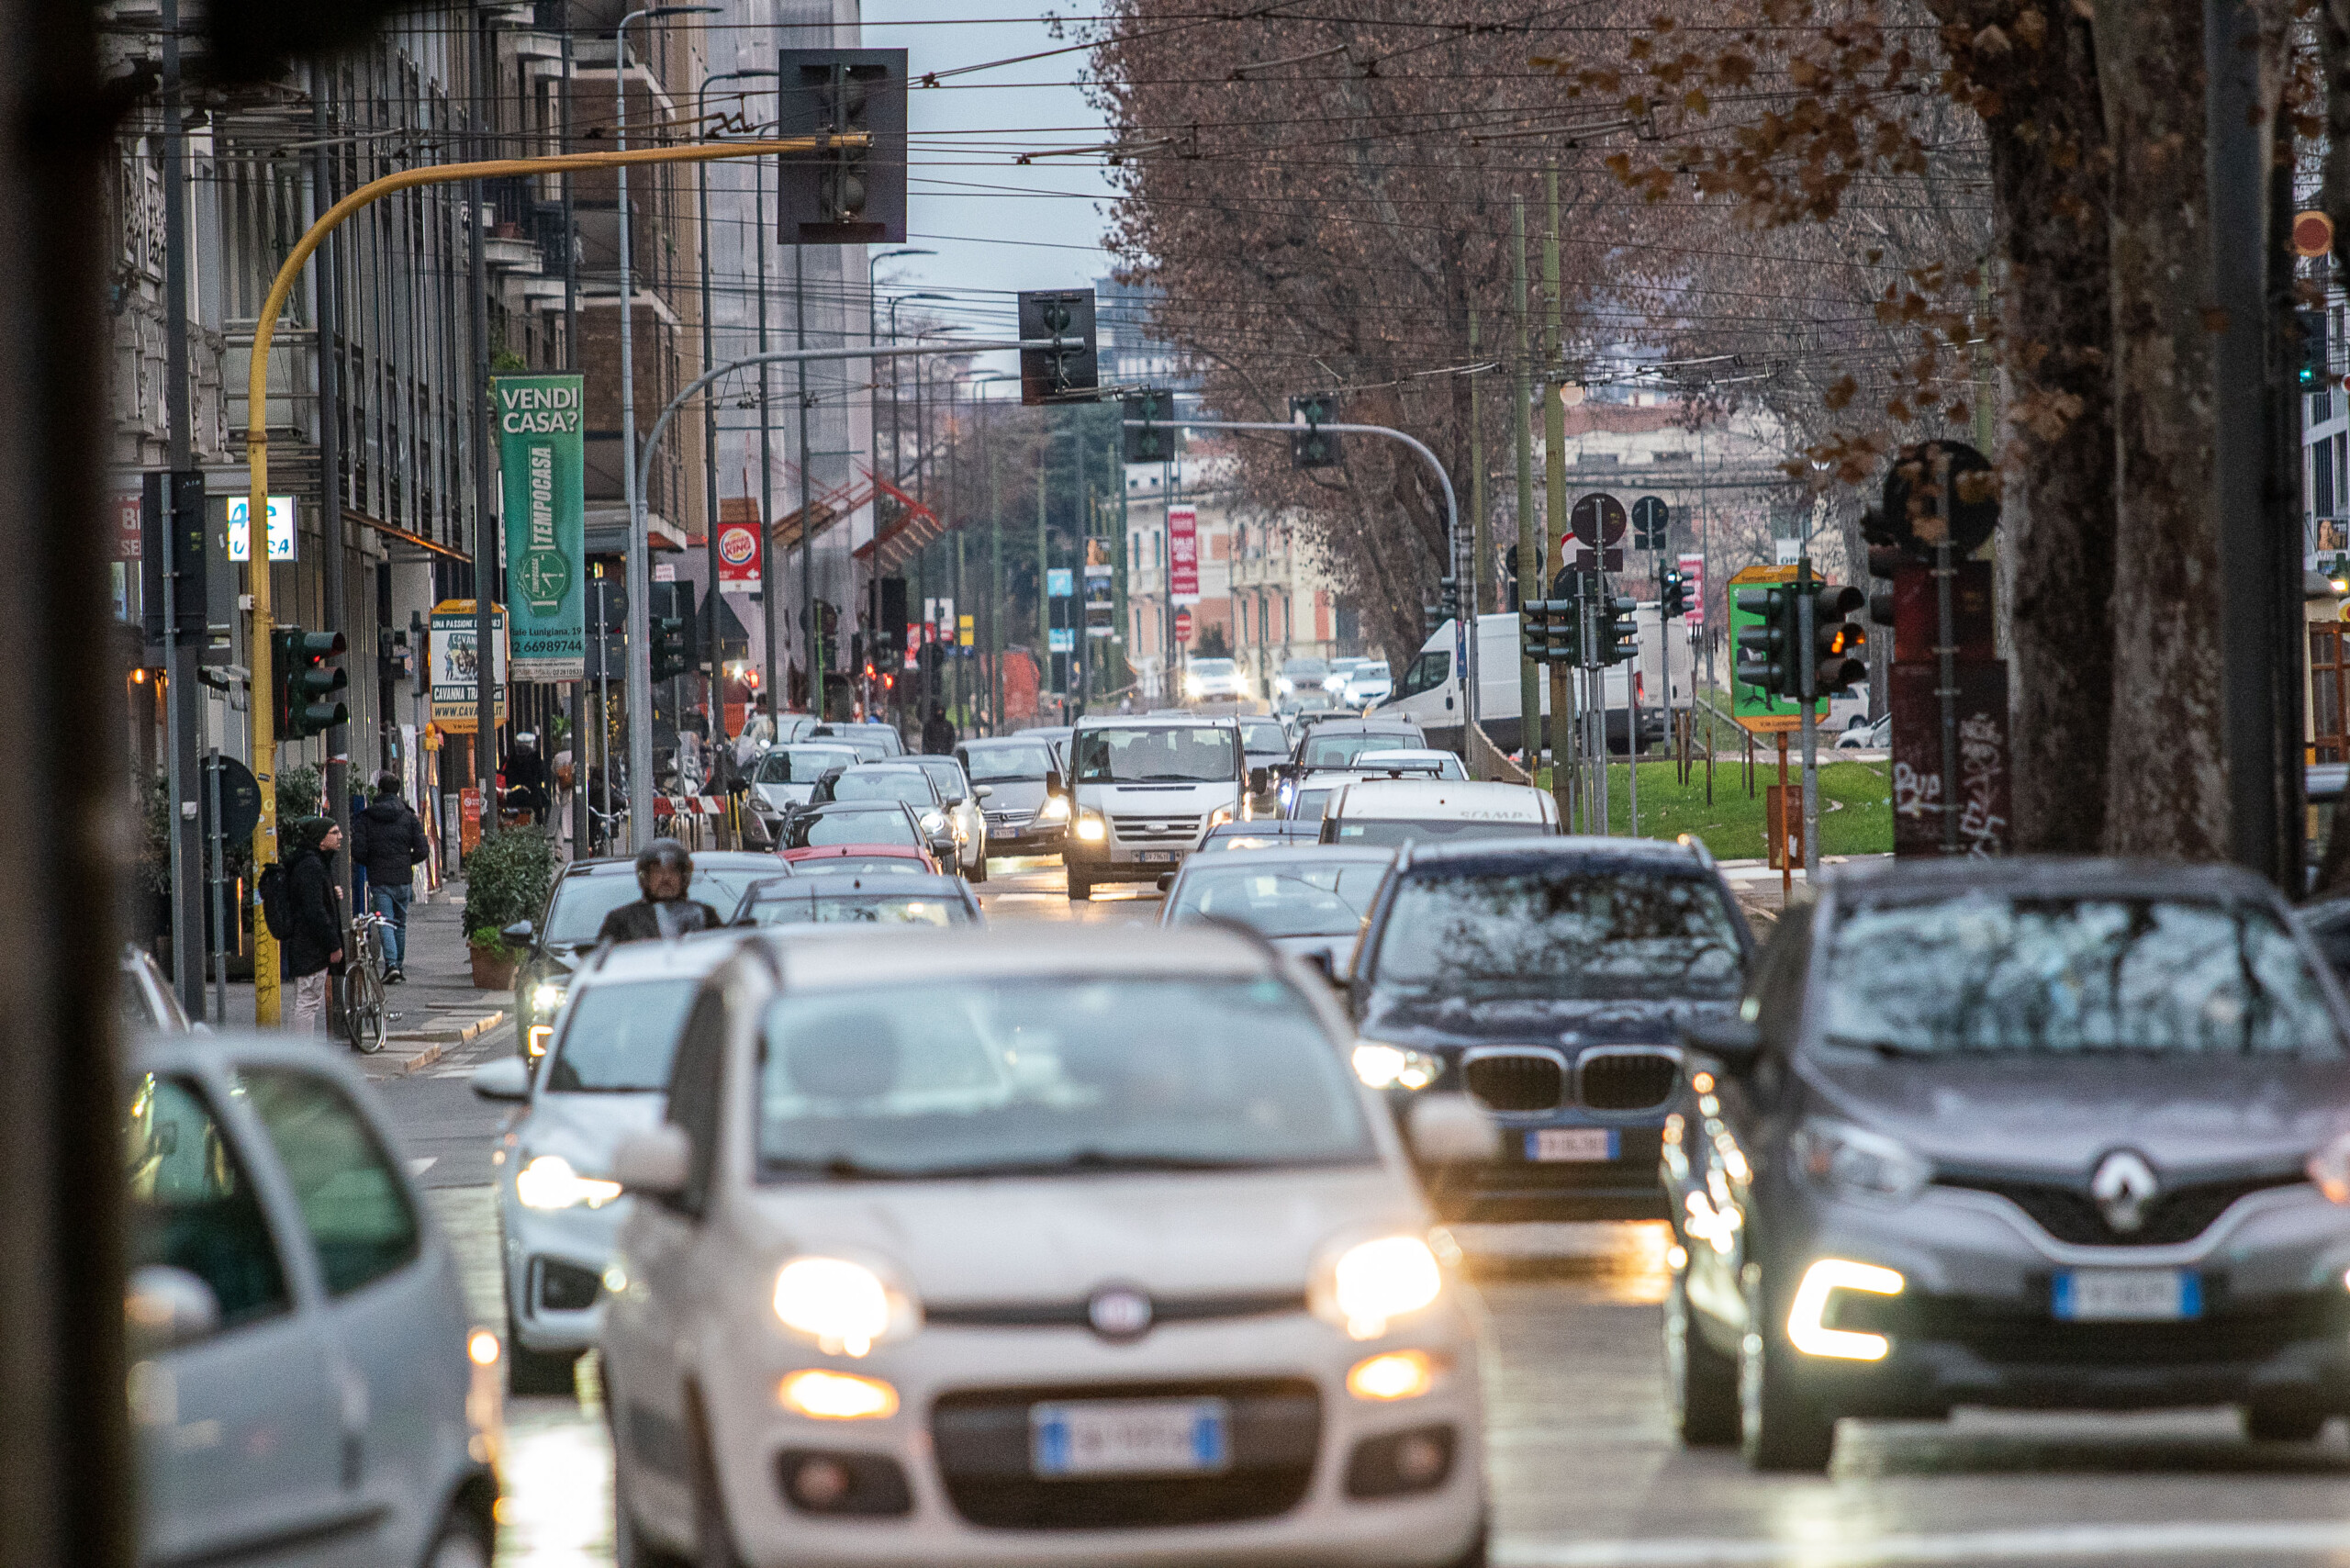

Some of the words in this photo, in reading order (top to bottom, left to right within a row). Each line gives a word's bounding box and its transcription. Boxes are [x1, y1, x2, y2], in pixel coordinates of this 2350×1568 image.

[501, 387, 577, 409] VENDI
[502, 411, 578, 434] CASA?
[532, 447, 553, 543] TEMPOCASA
[725, 541, 751, 555] KING
[432, 620, 444, 629] UNA
[445, 619, 473, 628] PASSIONE
[572, 626, 582, 635] 19
[523, 640, 582, 653] 66989744
[434, 687, 465, 700] CAVANNA
